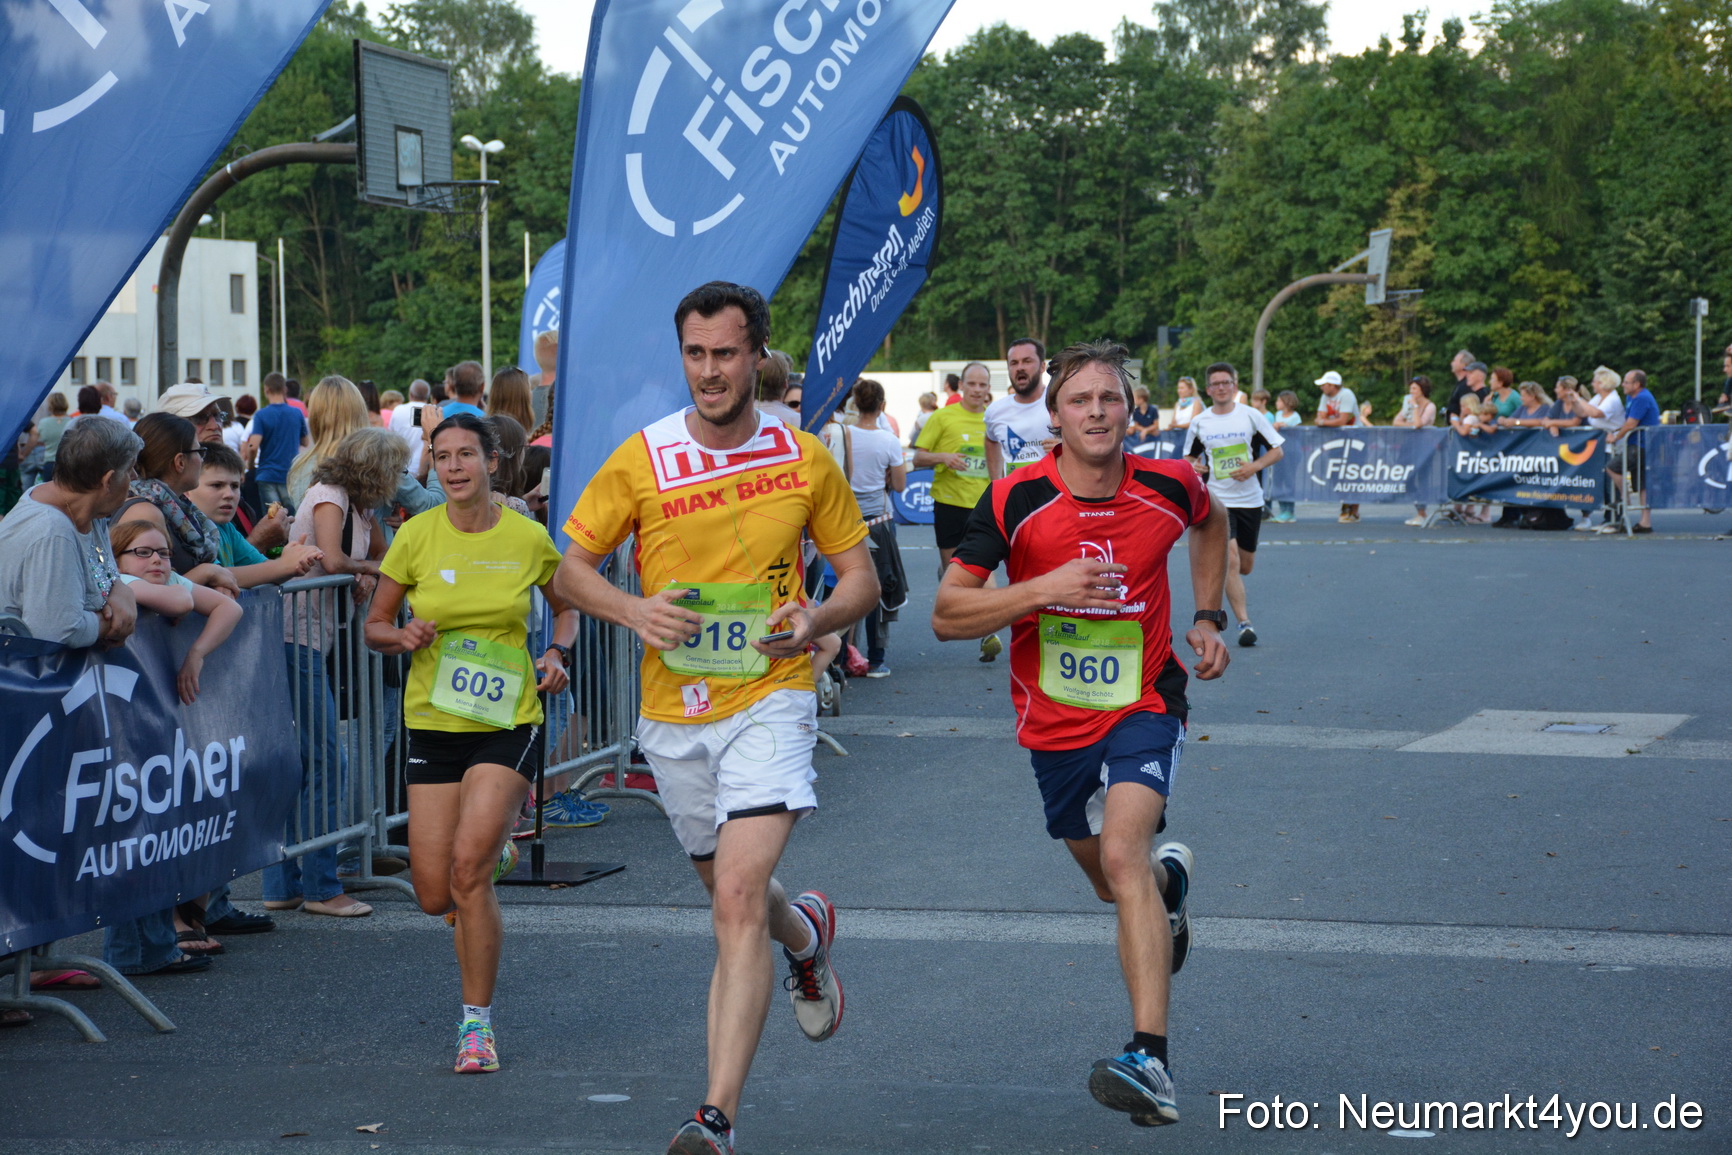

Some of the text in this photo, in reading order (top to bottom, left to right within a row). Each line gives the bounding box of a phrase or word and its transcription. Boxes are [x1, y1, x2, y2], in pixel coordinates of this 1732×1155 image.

[683, 0, 842, 181] Fisc
[769, 0, 890, 176] AUTOMO
[908, 206, 936, 260] Medien
[1206, 432, 1246, 441] DELPHI
[1326, 458, 1415, 481] Fischer
[1541, 475, 1558, 487] und
[661, 471, 808, 520] MAX BÖGL
[1333, 482, 1407, 493] AUTOMOBILE
[1120, 602, 1146, 613] GmbH
[686, 655, 711, 664] German
[1060, 652, 1120, 685] 960
[451, 667, 505, 703] 603
[1063, 686, 1091, 698] Wolfgang
[62, 728, 246, 835] Fischer
[75, 810, 237, 882] AUTOMOBILE
